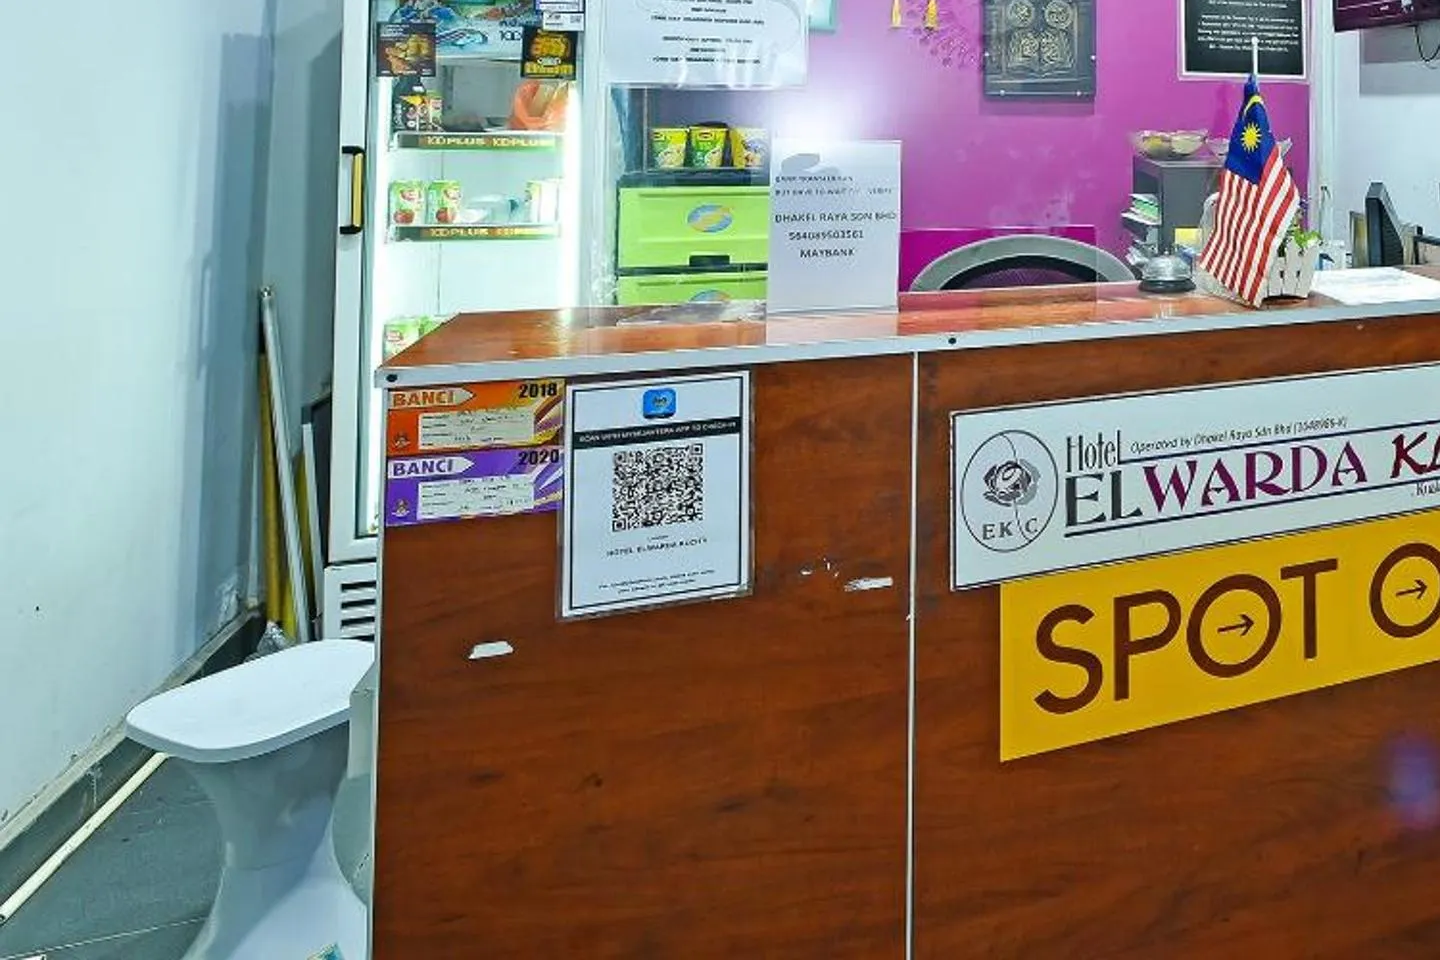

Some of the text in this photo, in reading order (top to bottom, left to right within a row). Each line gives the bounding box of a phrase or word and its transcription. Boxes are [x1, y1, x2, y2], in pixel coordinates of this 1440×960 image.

[819, 212, 848, 221] RAYA
[800, 247, 856, 258] MAYBANK
[393, 382, 558, 407] BANCI 2018
[1066, 429, 1121, 473] Hotel
[1130, 437, 1177, 454] Operated
[1180, 436, 1192, 449] by
[1230, 428, 1253, 442] Raya
[1255, 426, 1272, 438] Sdn
[393, 448, 560, 477] BANCI 2020
[1033, 558, 1339, 715] SPOT
